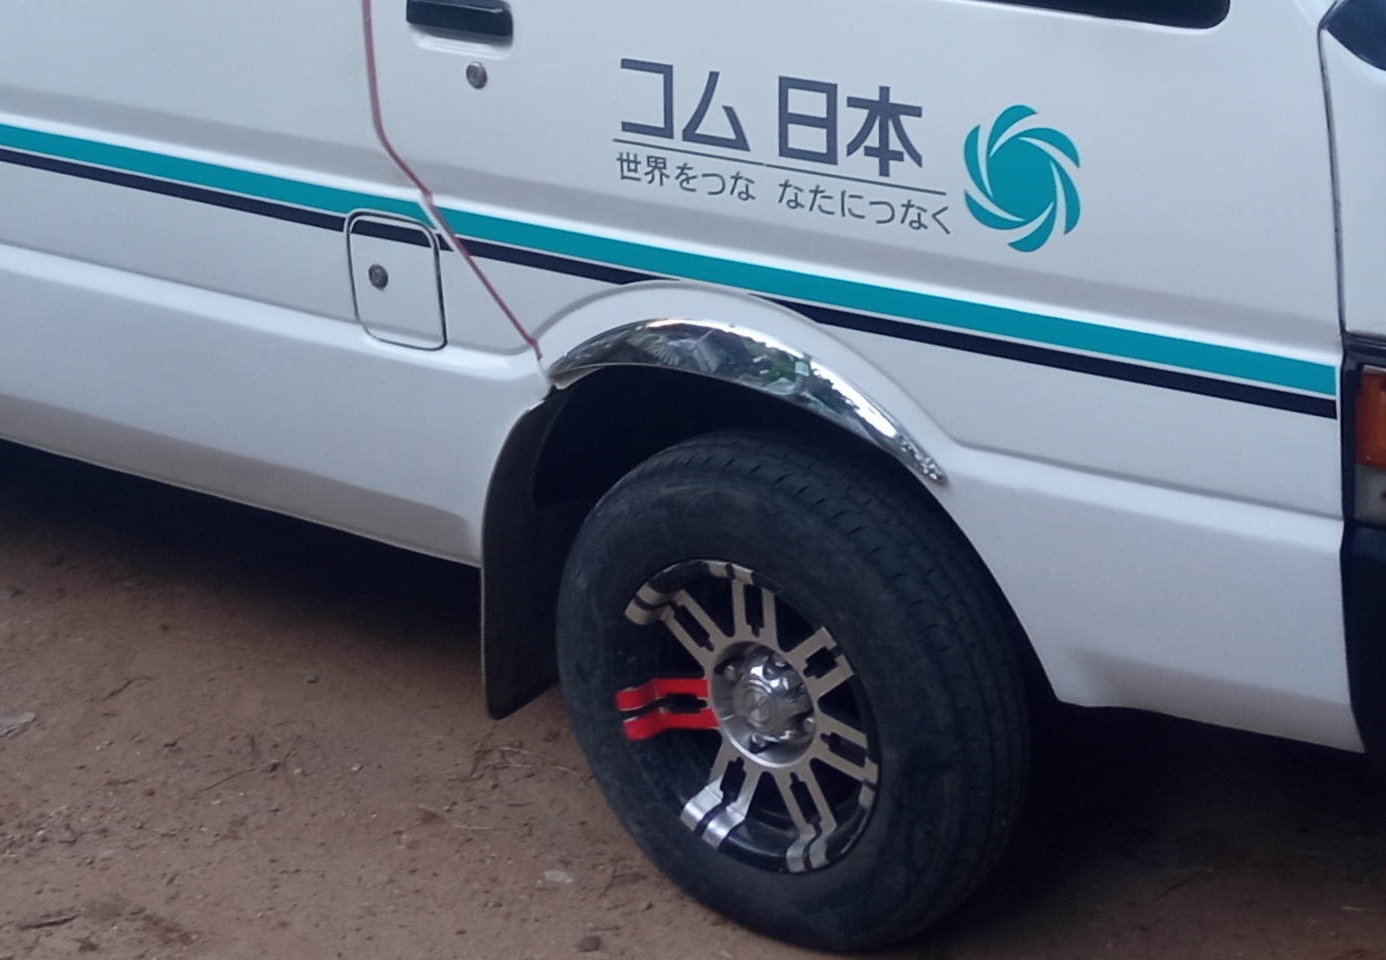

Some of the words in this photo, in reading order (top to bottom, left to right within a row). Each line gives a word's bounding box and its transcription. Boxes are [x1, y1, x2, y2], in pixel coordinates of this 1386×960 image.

[620, 57, 751, 152] コム
[778, 75, 923, 177] 日本
[616, 151, 756, 201] 世界をつな
[777, 178, 951, 235] なたにつなく
